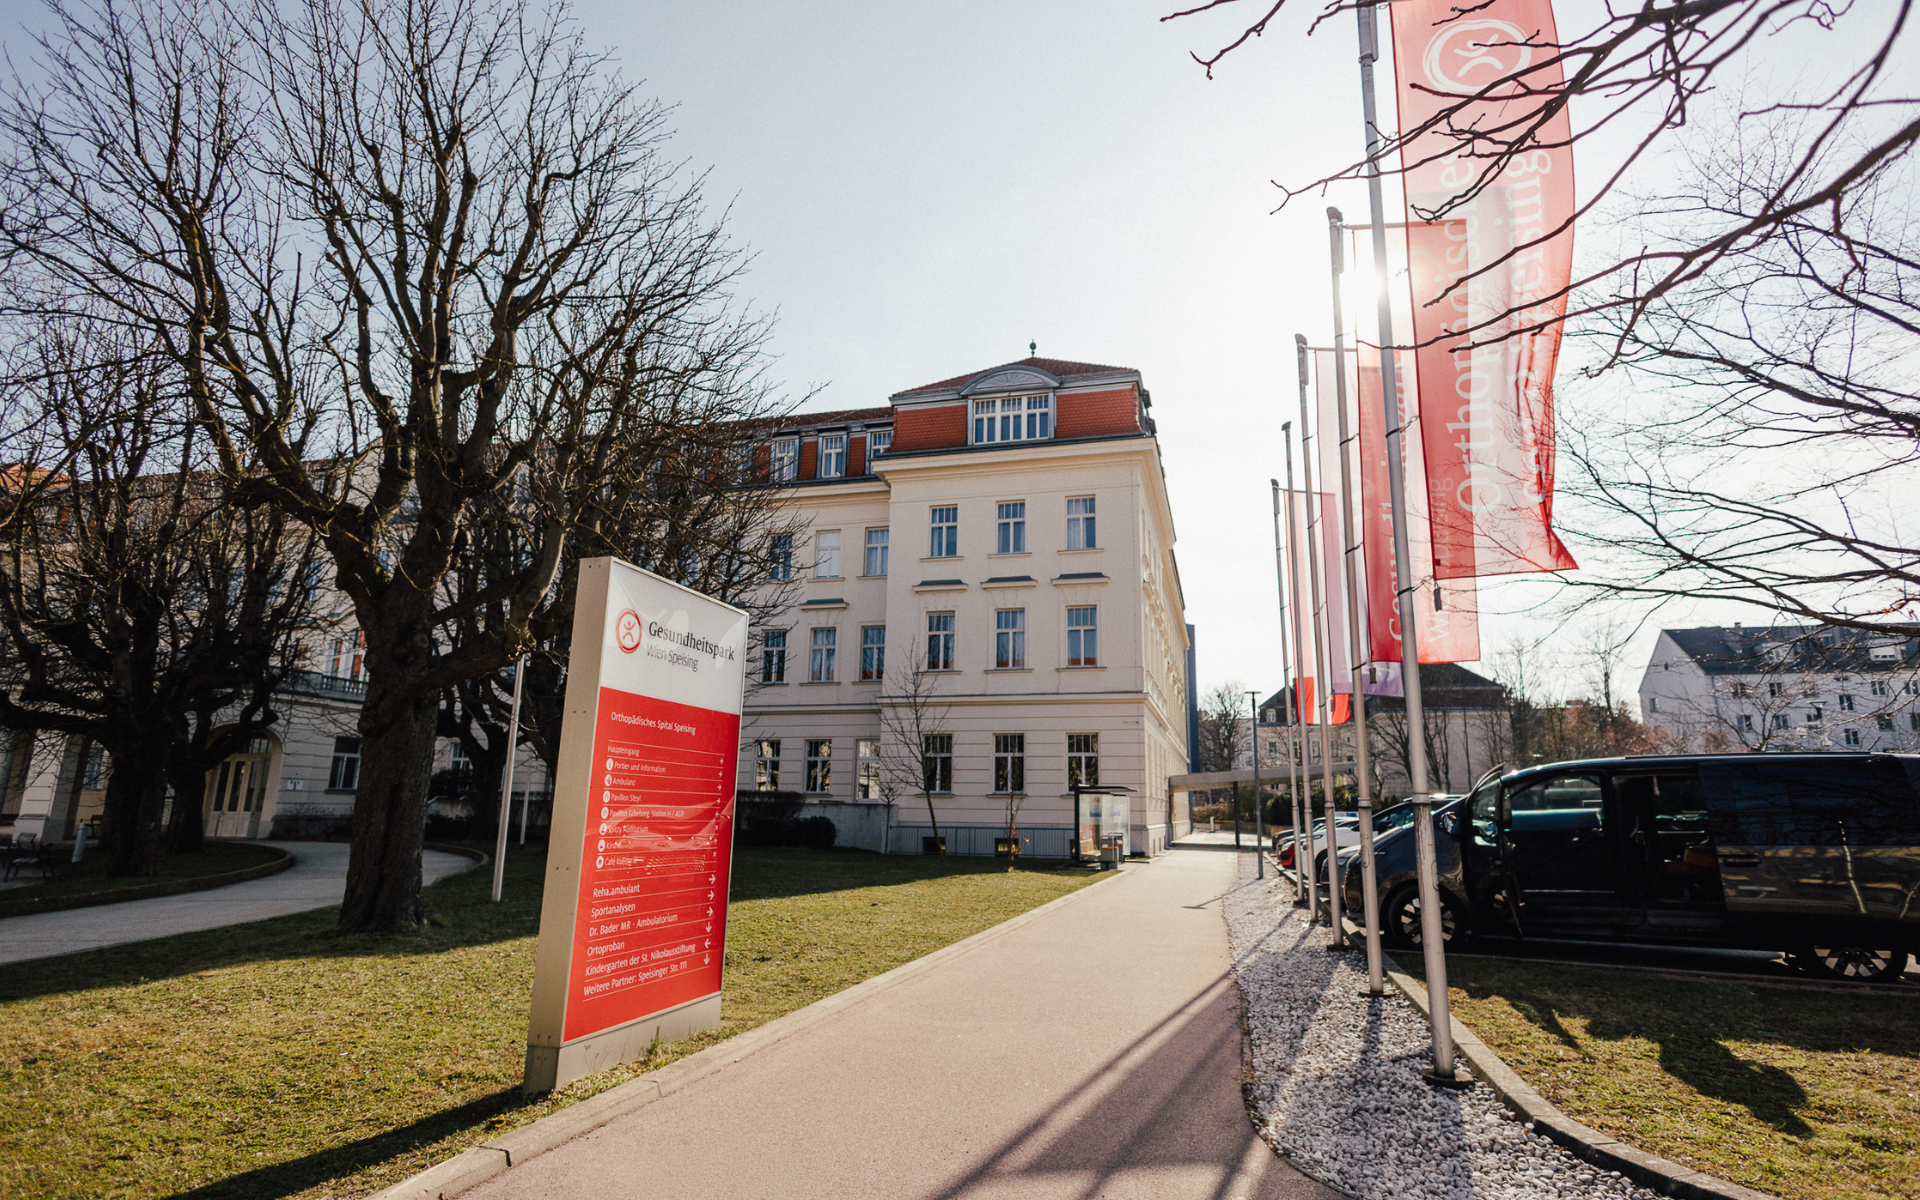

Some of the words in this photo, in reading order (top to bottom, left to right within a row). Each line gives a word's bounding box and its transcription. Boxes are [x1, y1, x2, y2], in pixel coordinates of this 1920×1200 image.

[648, 621, 735, 661] Gesundheitspark
[646, 643, 667, 661] Wien
[667, 650, 699, 673] Speising
[610, 711, 657, 728] Orthopädisches
[657, 720, 674, 731] Spital
[673, 723, 697, 736] Speising
[608, 745, 640, 757] Haupteingang
[614, 761, 630, 771] Portier
[630, 763, 640, 771] und
[640, 763, 667, 774] Information
[612, 777, 636, 787] Ambulanz
[592, 883, 640, 898] Reha.ambulant
[590, 903, 636, 919] Sportanalysen
[589, 926, 598, 937] Dr.
[599, 922, 619, 936] Bader
[620, 921, 631, 930] MR
[636, 914, 678, 928] Ambulatorium
[587, 941, 625, 956] Ortoproban
[585, 960, 628, 976] Kindergarten
[628, 955, 640, 966] der
[641, 953, 649, 964] St.
[651, 944, 696, 960] Nikolausstiftung
[583, 981, 610, 996] Weitere
[610, 974, 637, 989] Partner:
[638, 966, 669, 982] Speisinger
[669, 964, 678, 973] Str.
